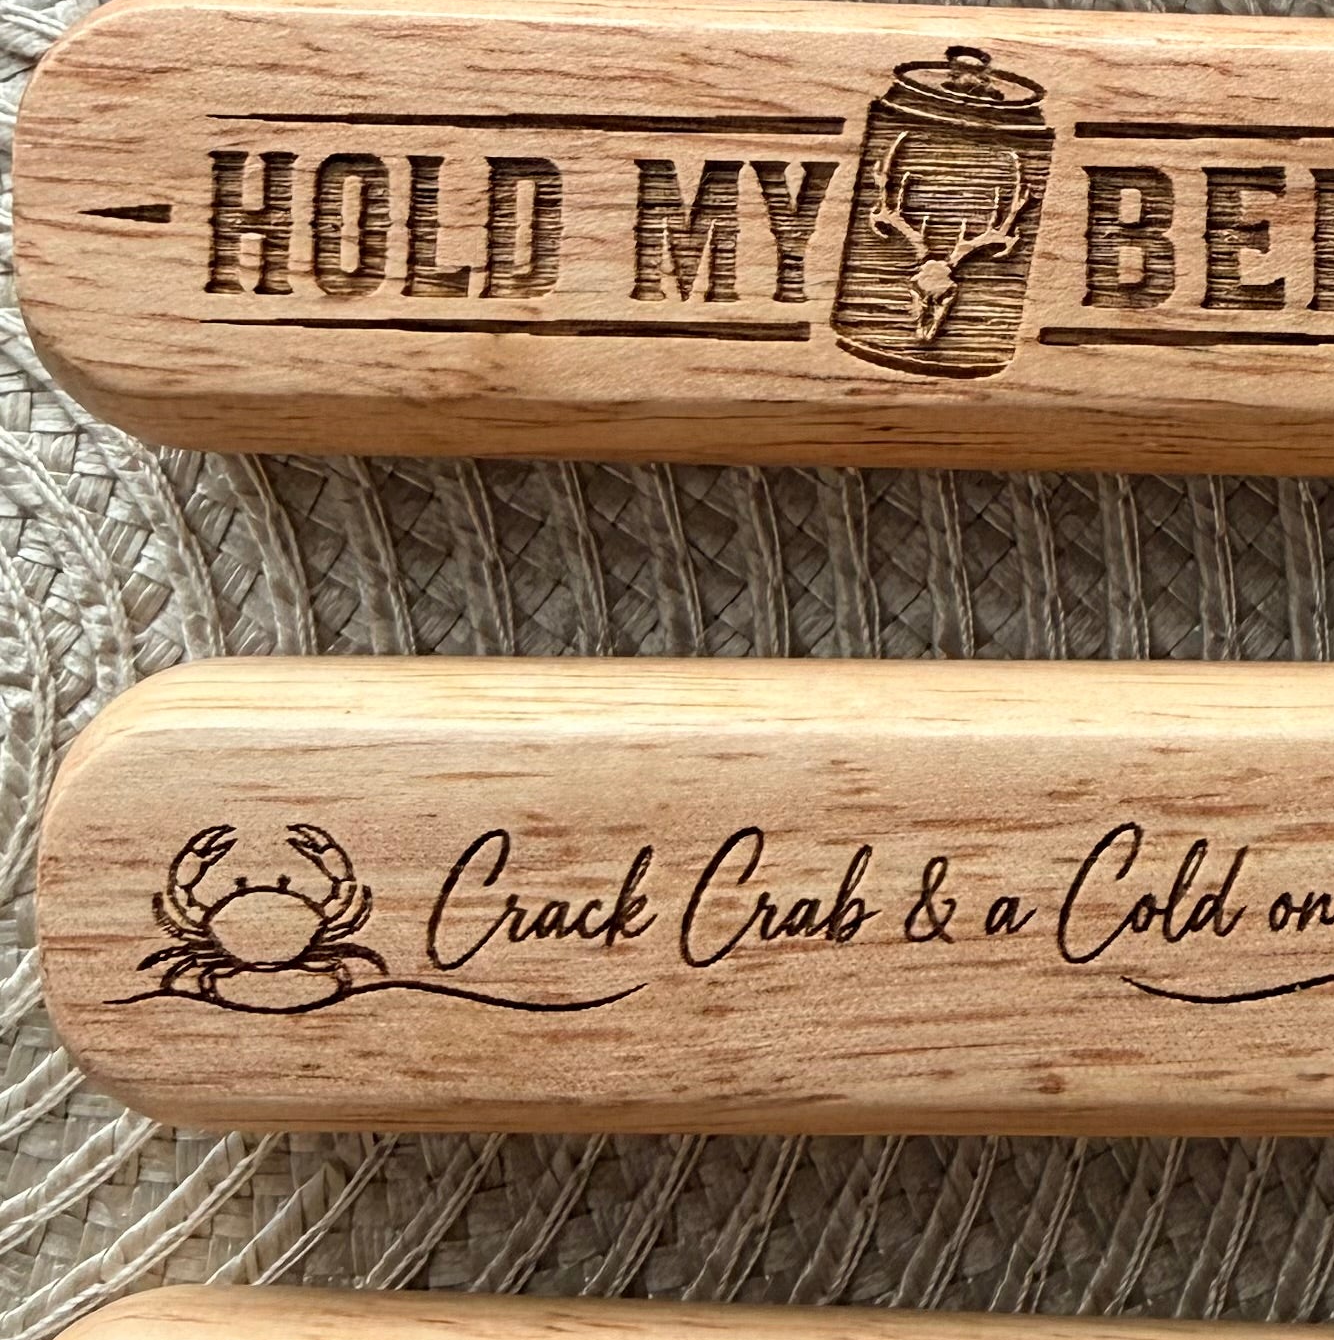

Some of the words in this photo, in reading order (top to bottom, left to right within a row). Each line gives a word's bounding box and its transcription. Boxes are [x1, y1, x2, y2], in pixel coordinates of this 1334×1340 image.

[203, 149, 565, 299] HOLD
[628, 158, 840, 304] MY
[426, 828, 657, 971] Crack
[681, 826, 884, 968] Crab
[903, 856, 957, 945] &
[985, 895, 1037, 936] a
[1056, 822, 1250, 964] Cold
